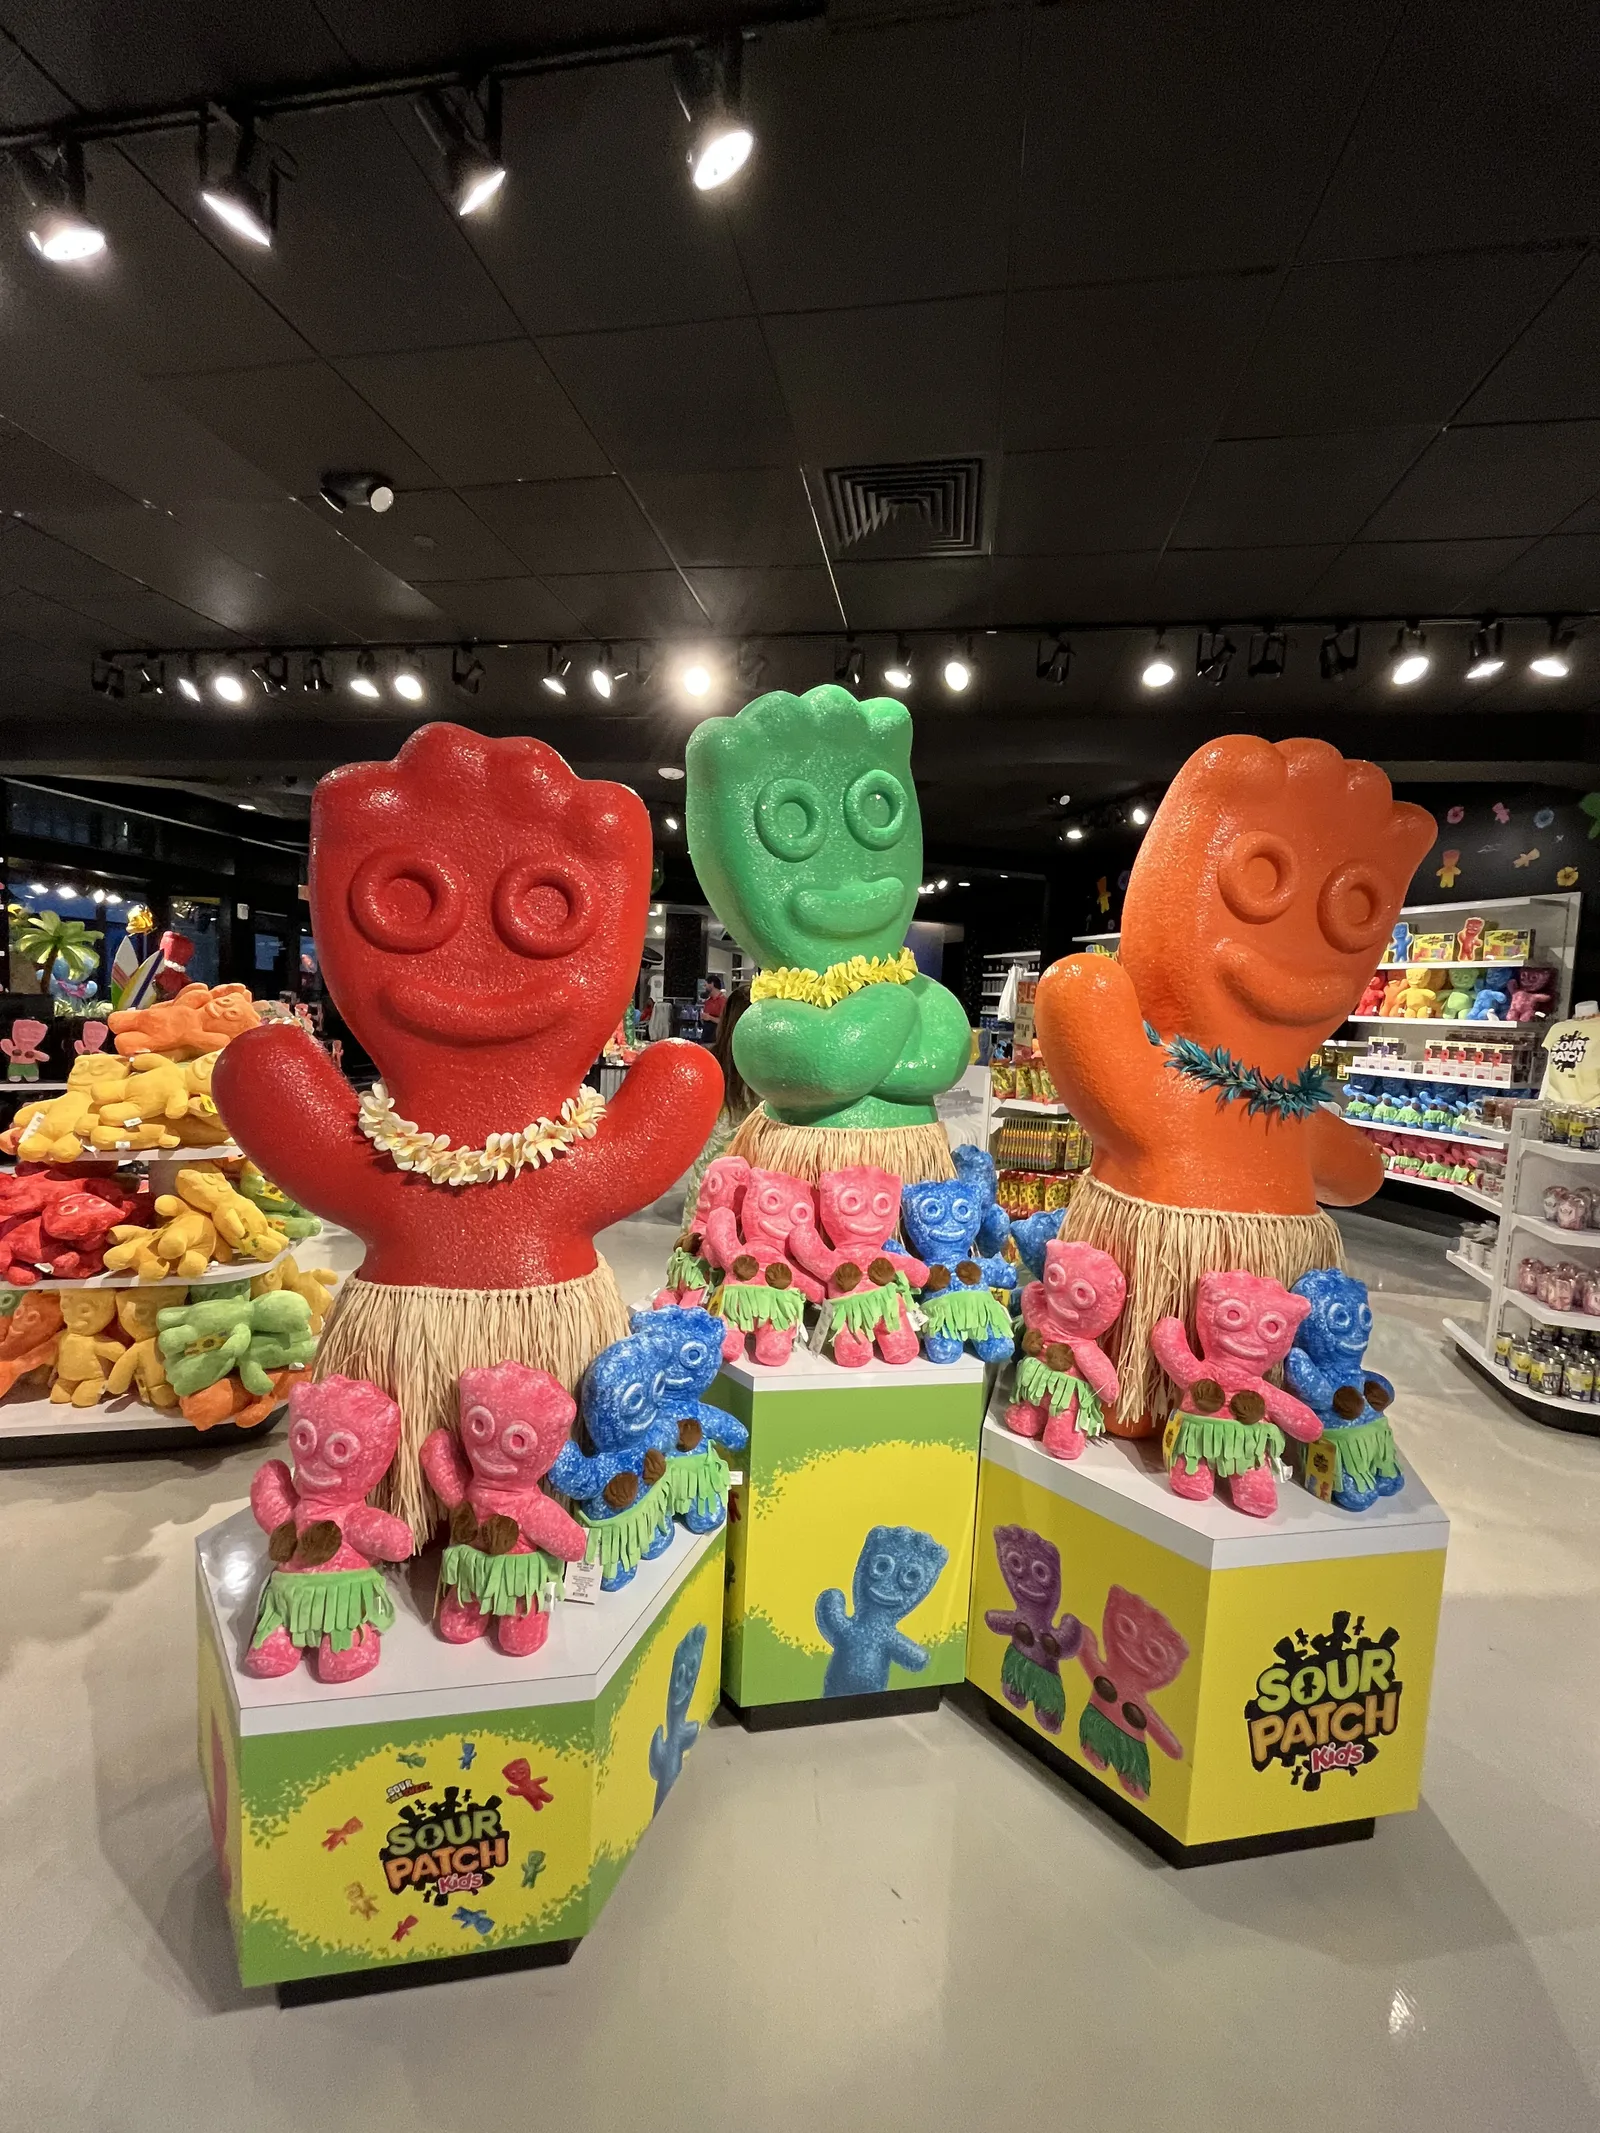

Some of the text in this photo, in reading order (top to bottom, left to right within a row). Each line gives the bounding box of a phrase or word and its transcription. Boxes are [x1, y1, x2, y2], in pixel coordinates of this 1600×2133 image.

[1550, 1050, 1584, 1062] PATCH
[1551, 1039, 1585, 1051] SOUR
[1257, 1648, 1393, 1713] SOUR
[1250, 1691, 1397, 1763] PATCH
[1311, 1742, 1364, 1773] Kids
[387, 1779, 413, 1796] SOUR
[387, 1808, 499, 1856] SOUR
[384, 1837, 508, 1889] PATCH
[437, 1872, 483, 1894] Kids
